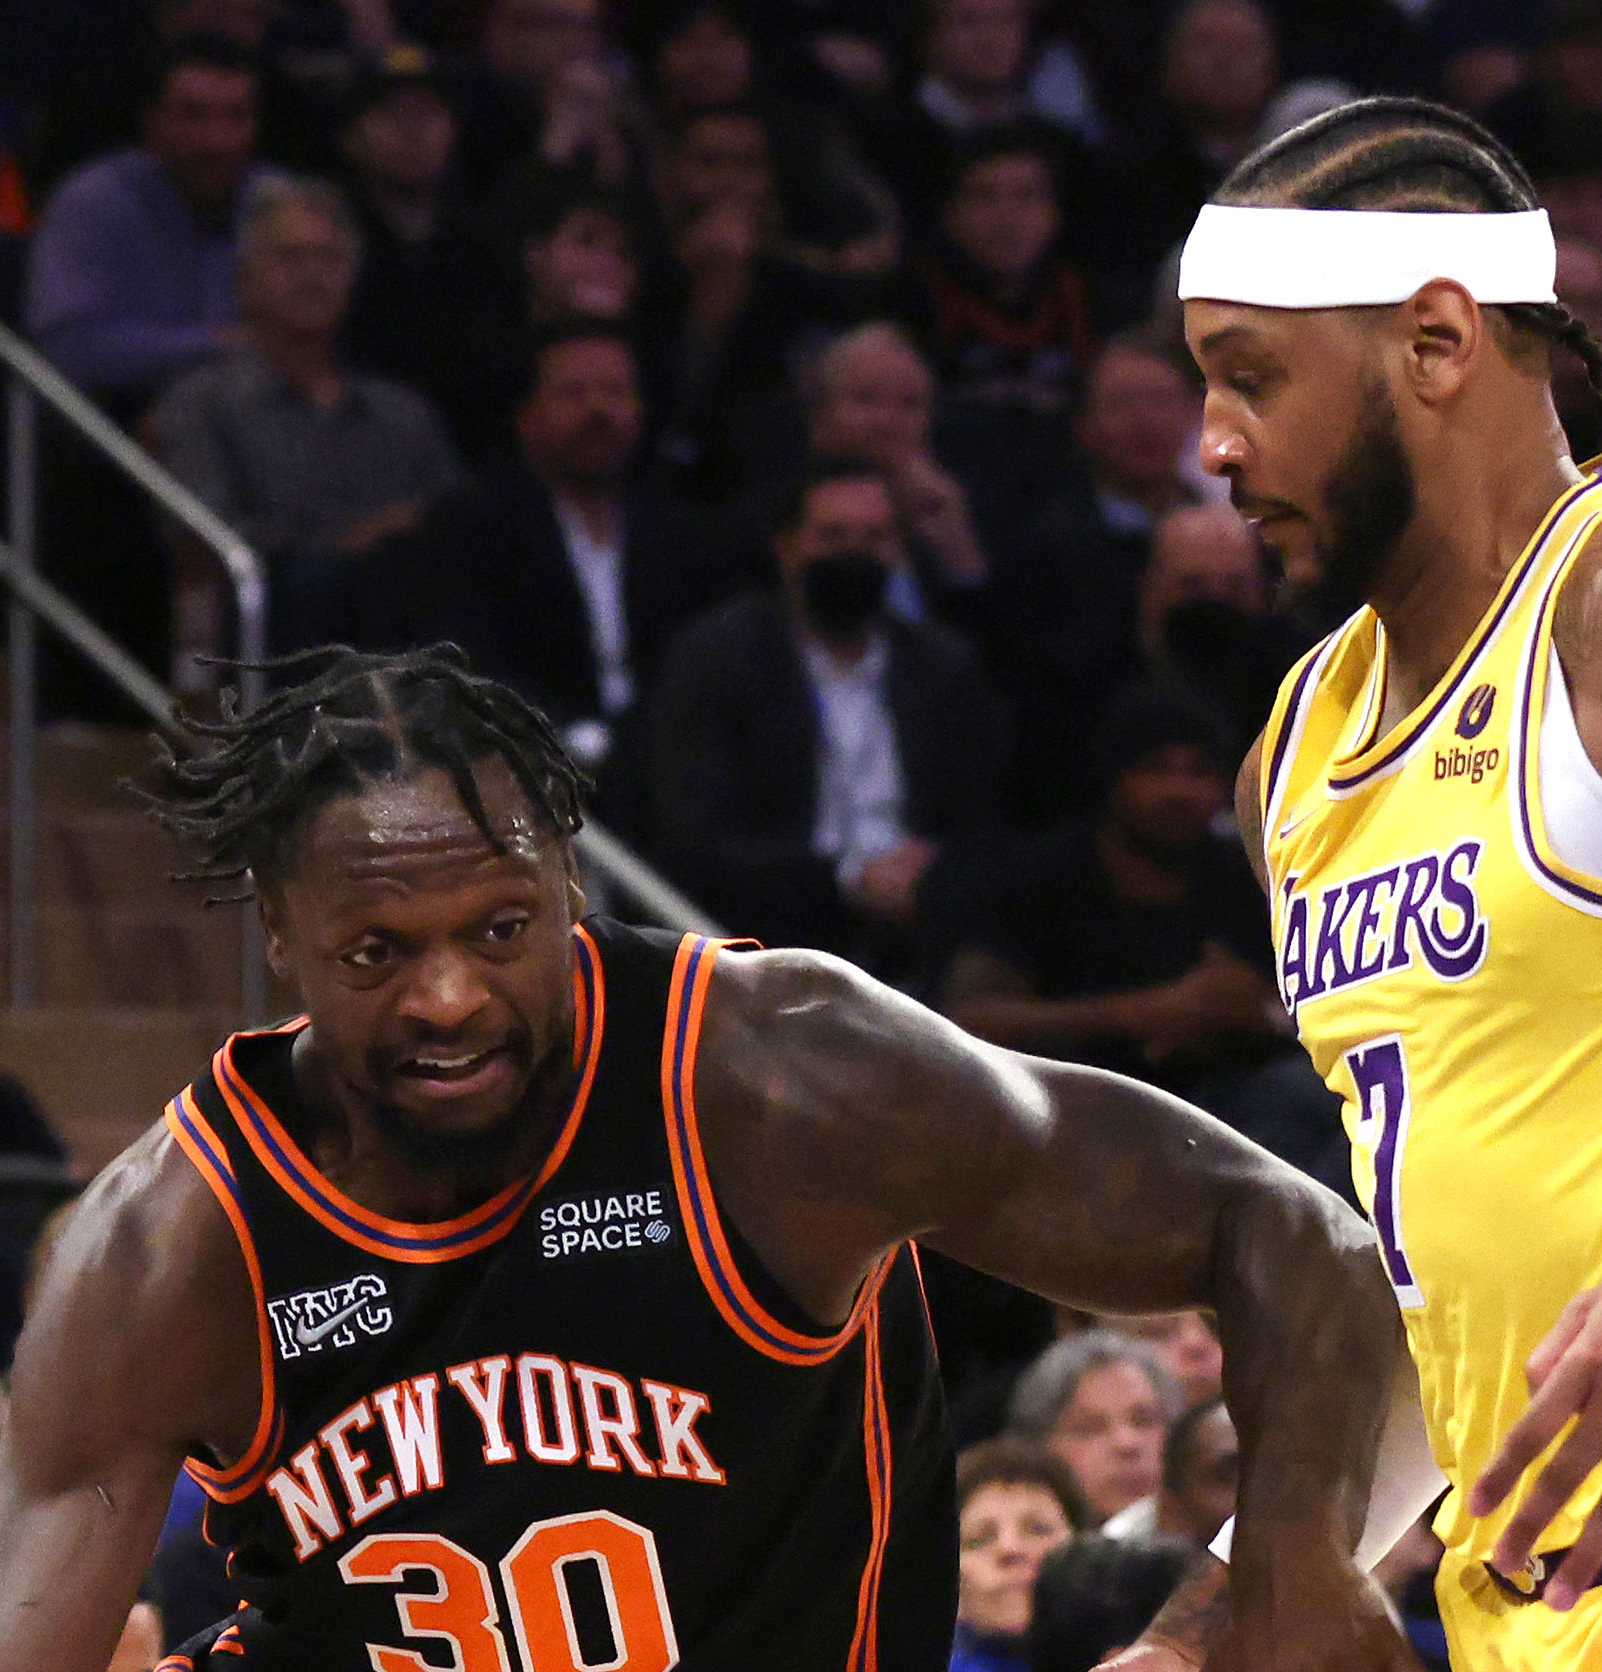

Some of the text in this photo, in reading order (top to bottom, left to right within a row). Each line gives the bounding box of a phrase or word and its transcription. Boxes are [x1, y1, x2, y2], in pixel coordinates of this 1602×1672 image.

[1434, 745, 1499, 784] bibigo
[1279, 840, 1488, 1011] AKERS
[540, 1191, 663, 1231] SQUARE
[1343, 1035, 1422, 1305] 7
[542, 1219, 642, 1258] SPACE
[265, 1352, 727, 1564] NEW YORK
